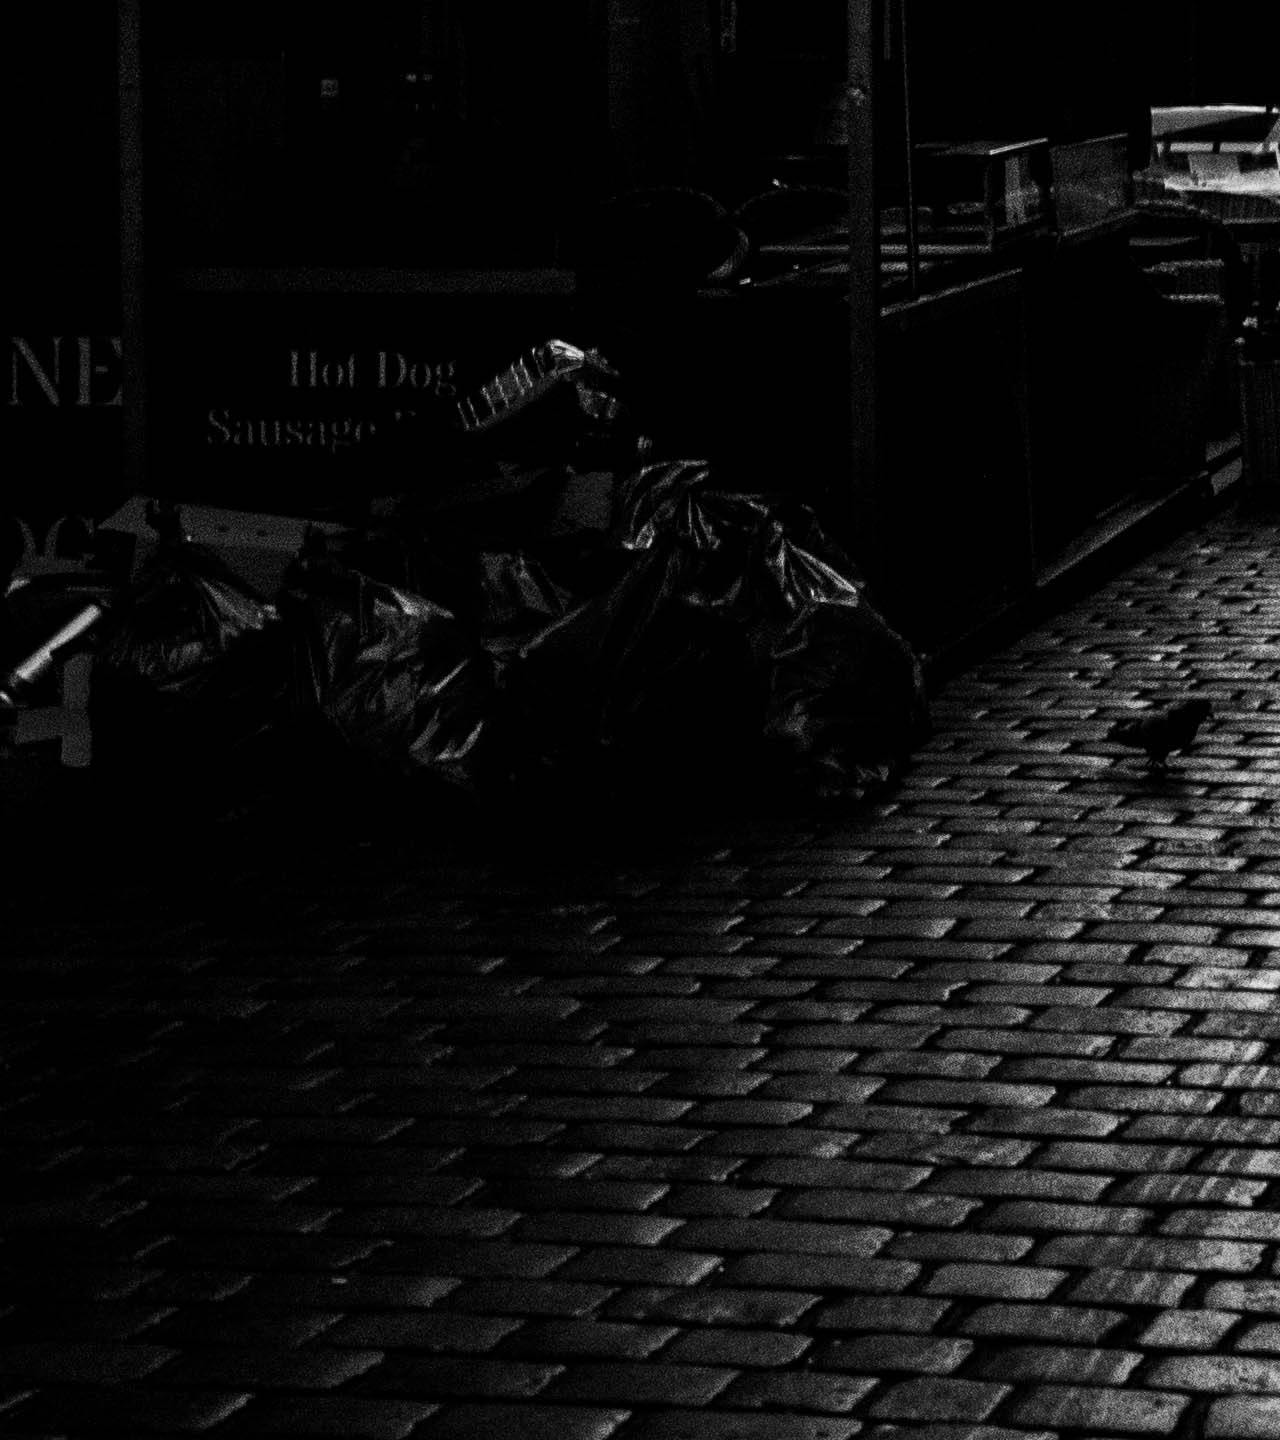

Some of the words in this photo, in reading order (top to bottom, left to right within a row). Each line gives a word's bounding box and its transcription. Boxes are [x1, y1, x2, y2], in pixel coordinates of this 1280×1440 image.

[289, 350, 357, 388] Hot
[377, 350, 457, 397] Dog
[206, 408, 377, 454] Sausage
